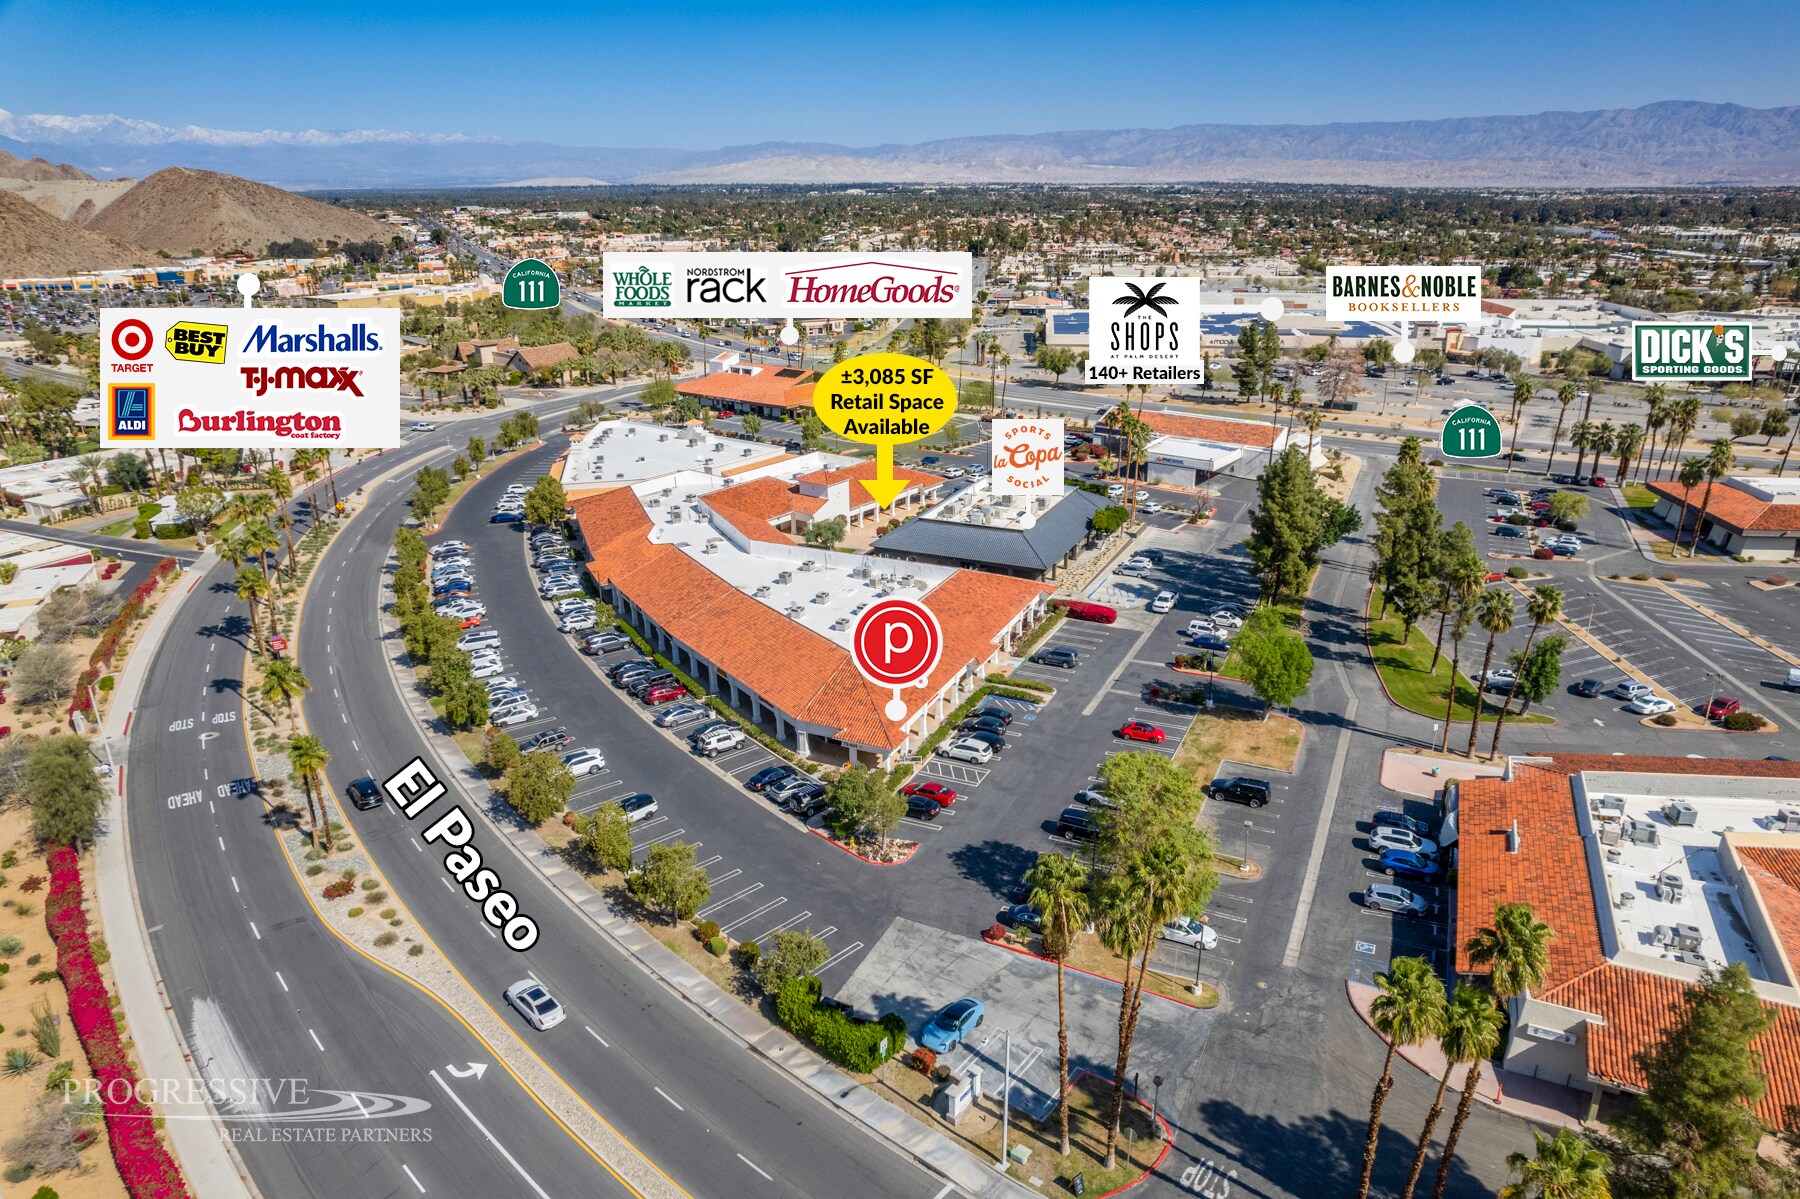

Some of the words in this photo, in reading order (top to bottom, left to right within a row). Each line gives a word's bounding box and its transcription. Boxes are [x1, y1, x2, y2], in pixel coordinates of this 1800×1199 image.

[168, 718, 194, 732] STOP
[211, 711, 236, 724] STOP
[217, 779, 252, 798] AHEAD
[167, 789, 202, 810] AHEAD
[1179, 1156, 1238, 1199] STOP
